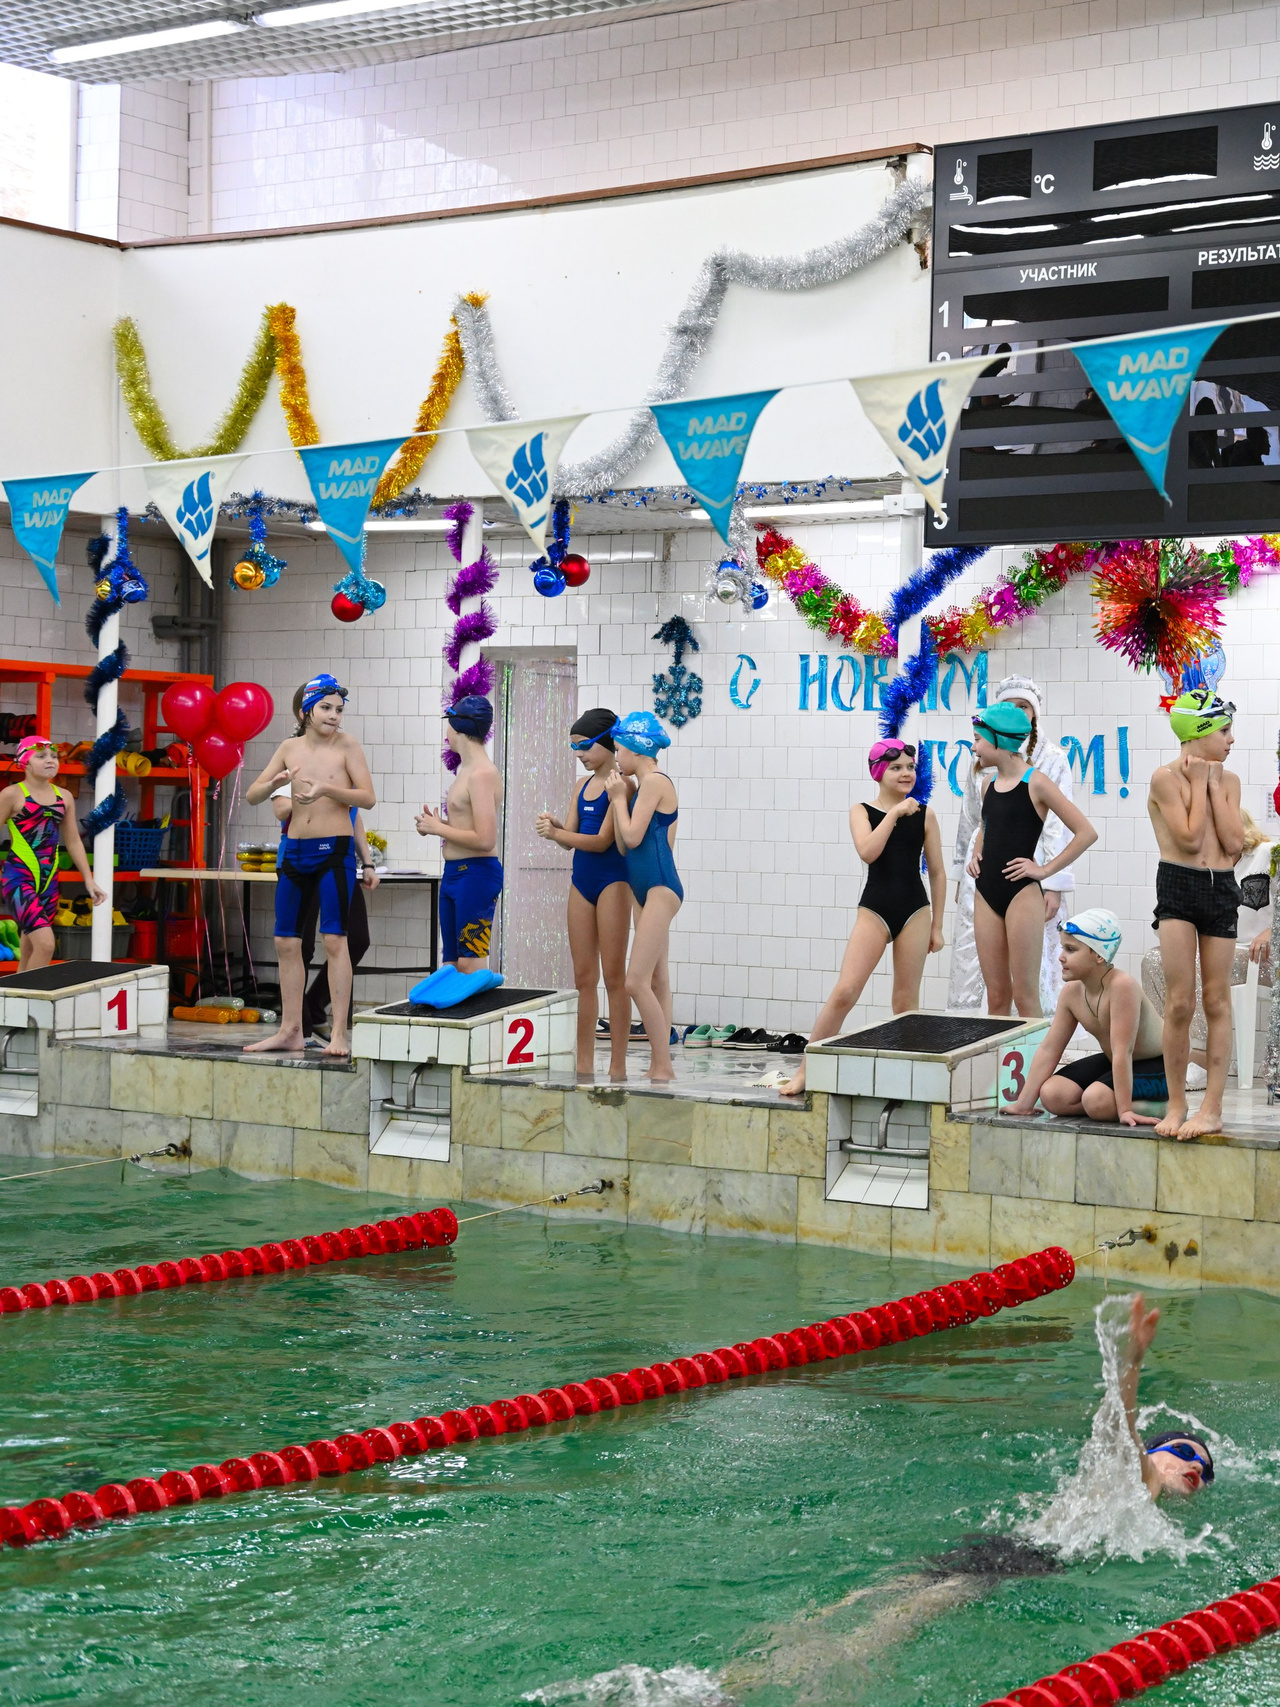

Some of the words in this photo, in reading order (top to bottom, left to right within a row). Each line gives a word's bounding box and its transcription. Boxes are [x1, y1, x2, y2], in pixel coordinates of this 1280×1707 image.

[1019, 262, 1098, 283] УЧАСТНИК
[938, 300, 949, 328] 1
[1118, 347, 1189, 376] MAD
[687, 411, 747, 437] MAD
[328, 455, 380, 478] MAD
[32, 488, 72, 508] MAD
[729, 653, 762, 710] С
[107, 989, 128, 1031] 1
[507, 1018, 535, 1065] 2
[1001, 1050, 1025, 1102] 3
